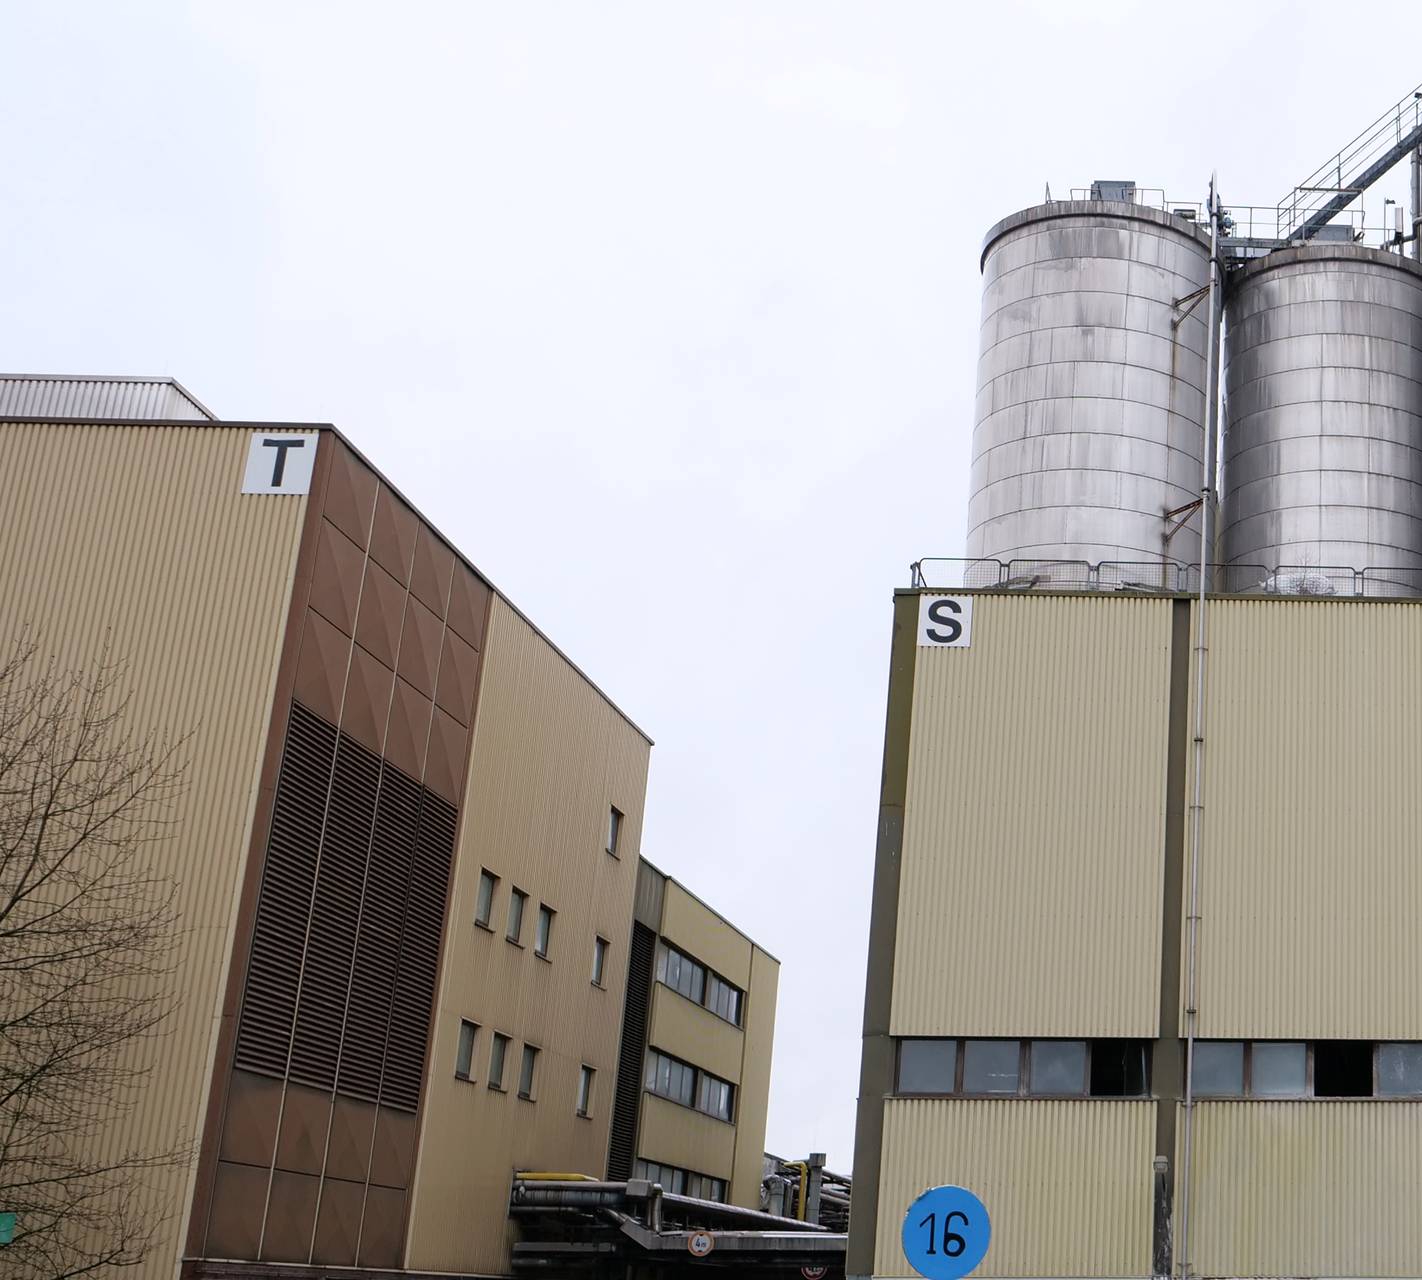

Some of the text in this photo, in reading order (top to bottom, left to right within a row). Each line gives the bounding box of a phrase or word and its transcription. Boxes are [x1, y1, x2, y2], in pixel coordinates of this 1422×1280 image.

[262, 438, 305, 487] T
[926, 599, 962, 643] S
[919, 1210, 969, 1257] 16
